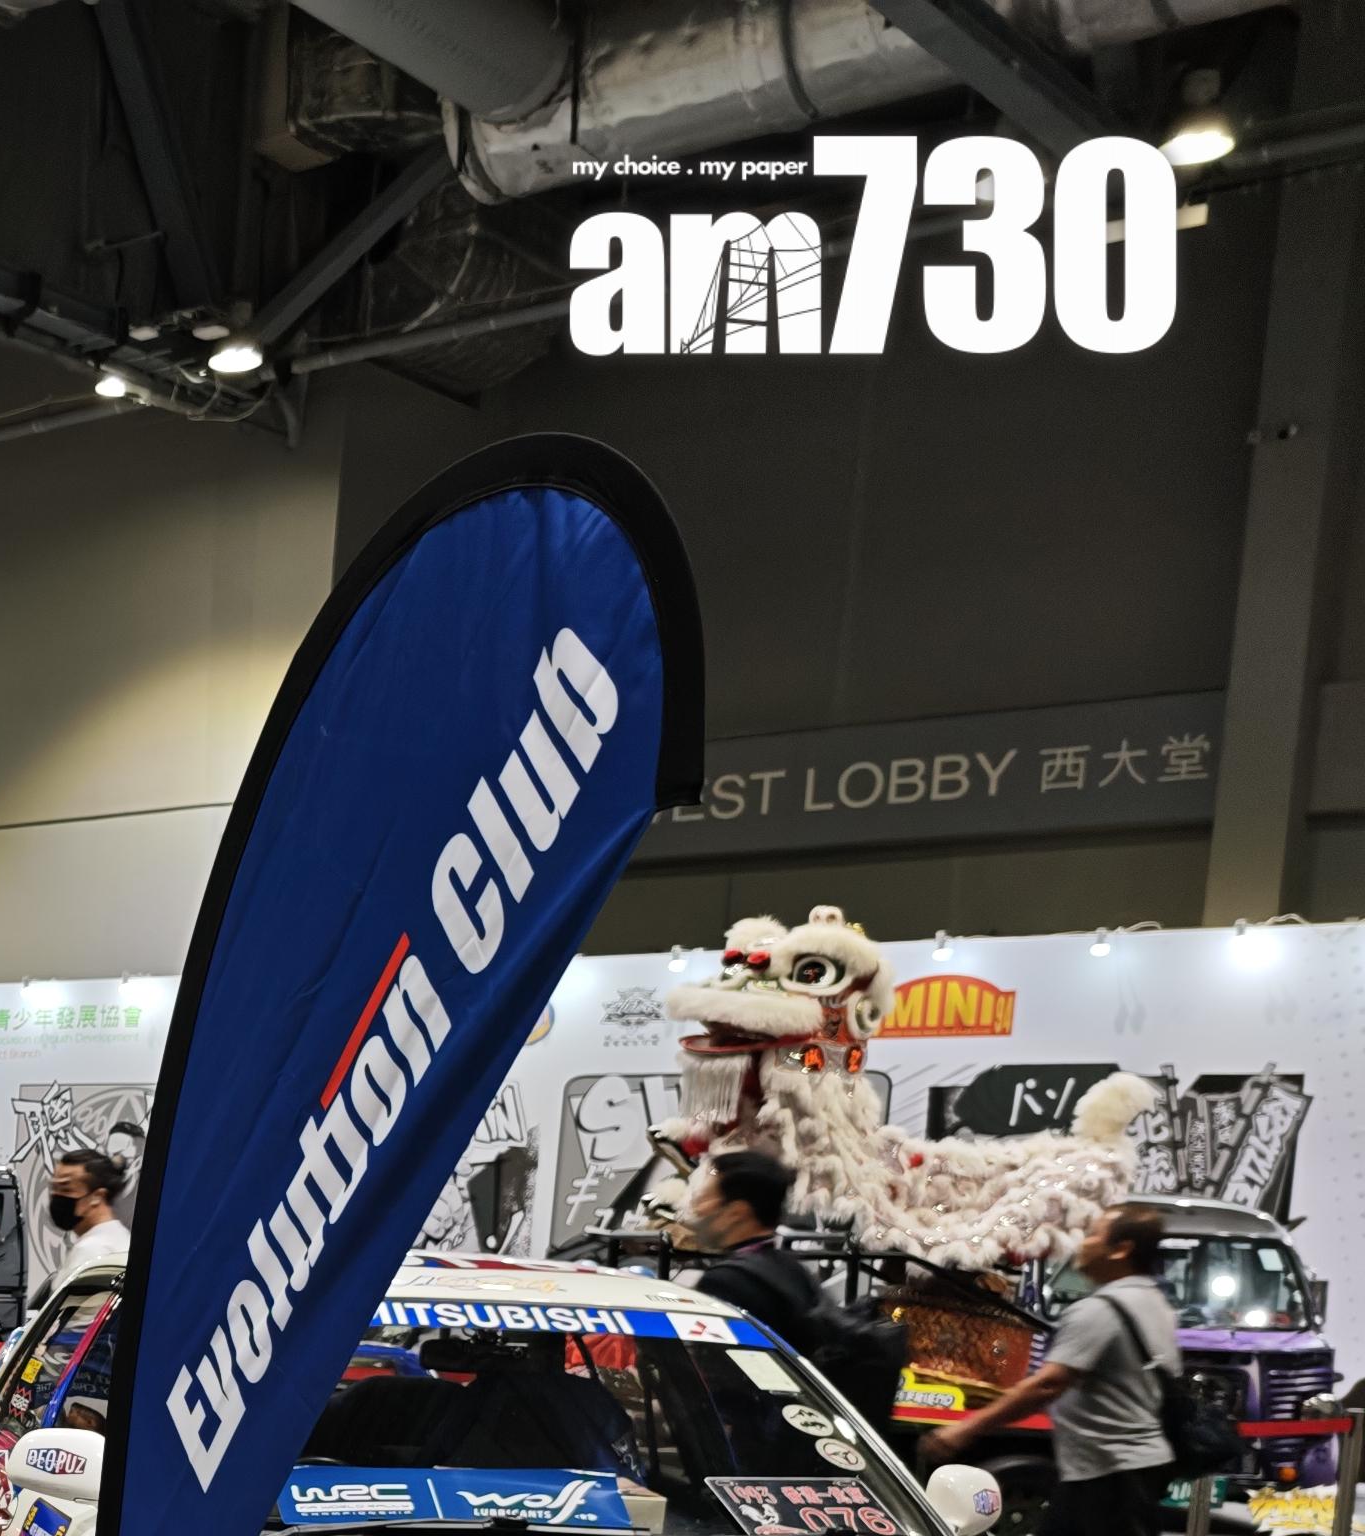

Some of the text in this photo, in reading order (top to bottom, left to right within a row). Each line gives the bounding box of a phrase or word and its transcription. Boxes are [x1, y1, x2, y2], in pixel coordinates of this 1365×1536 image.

[652, 749, 1018, 824] ST LOBBY
[1040, 735, 1211, 793] 西大堂
[884, 980, 995, 1028] MINI
[166, 945, 453, 1493] Evolution
[431, 625, 618, 975] Club
[290, 1484, 412, 1501] WRC
[723, 1486, 778, 1504] 1993
[799, 1506, 897, 1536] 076
